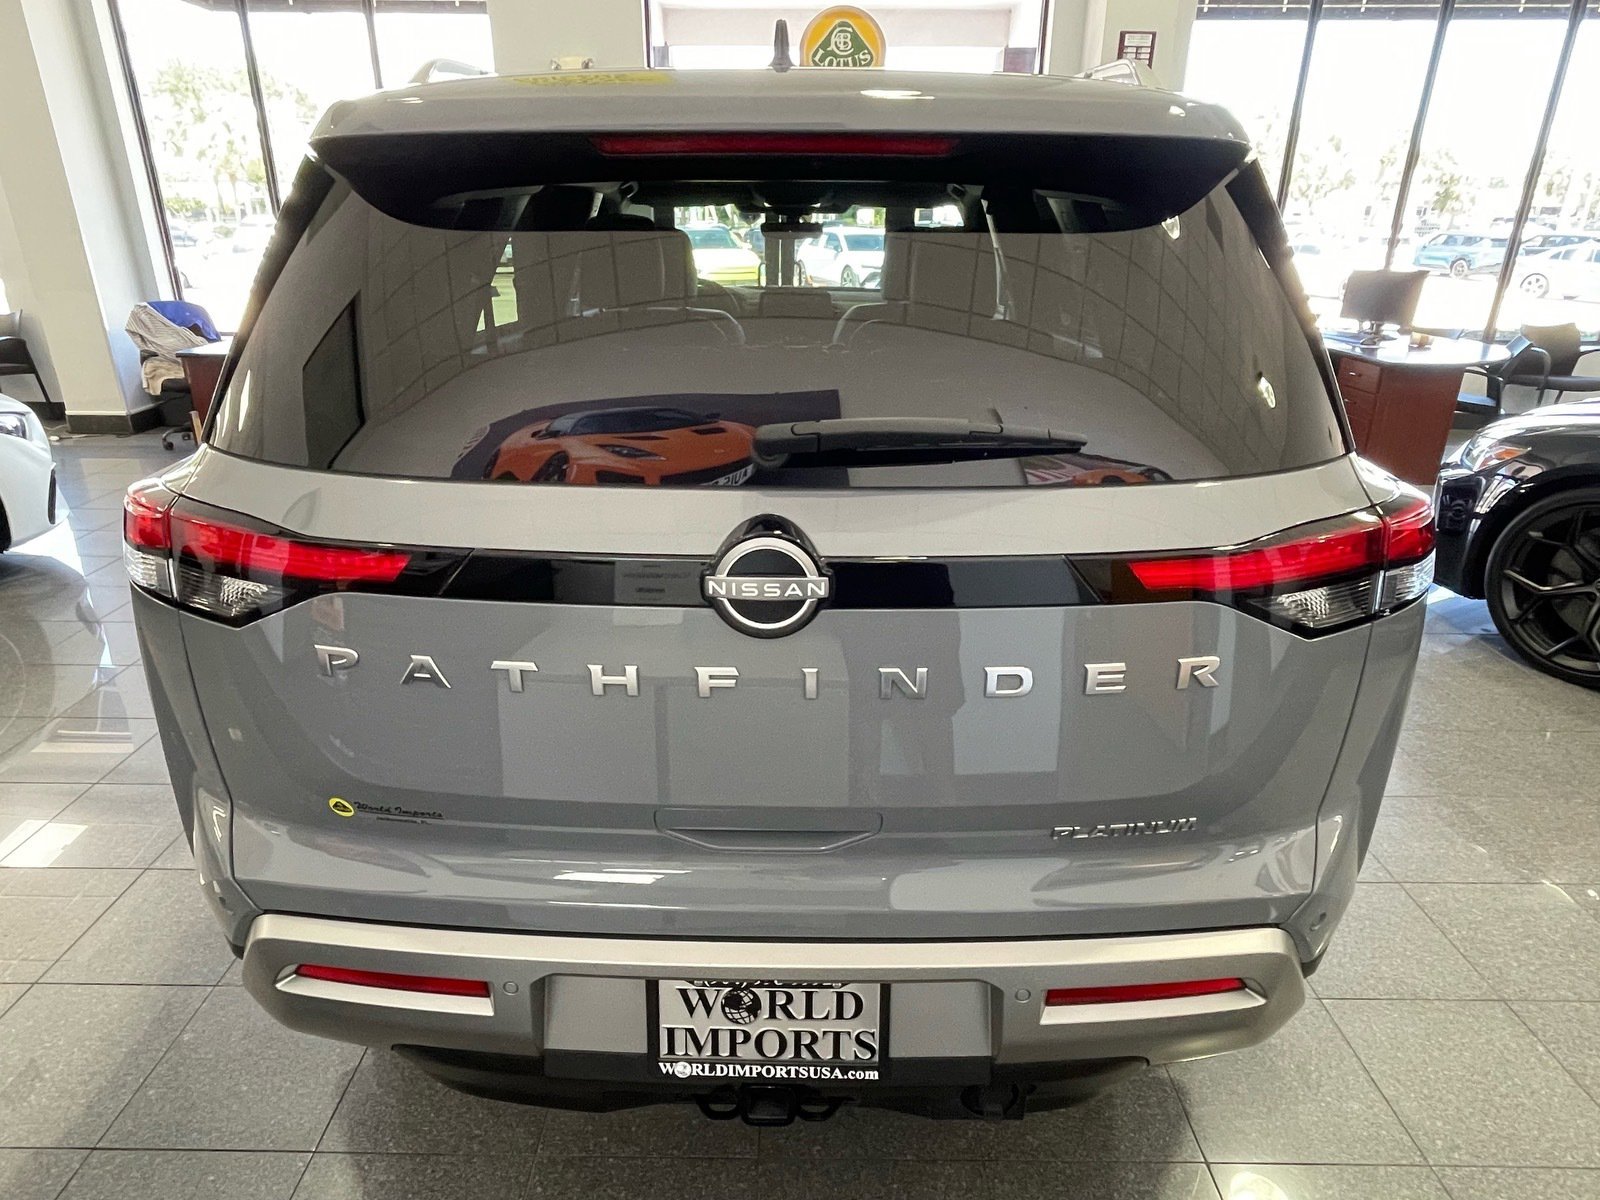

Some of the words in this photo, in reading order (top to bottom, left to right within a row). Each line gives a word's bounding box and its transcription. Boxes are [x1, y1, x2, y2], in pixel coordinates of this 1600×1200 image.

[708, 580, 826, 597] NISSAN
[314, 644, 1221, 700] PATHFINDER
[1051, 817, 1198, 841] PLATINUM
[662, 1026, 878, 1061] IMPORTS
